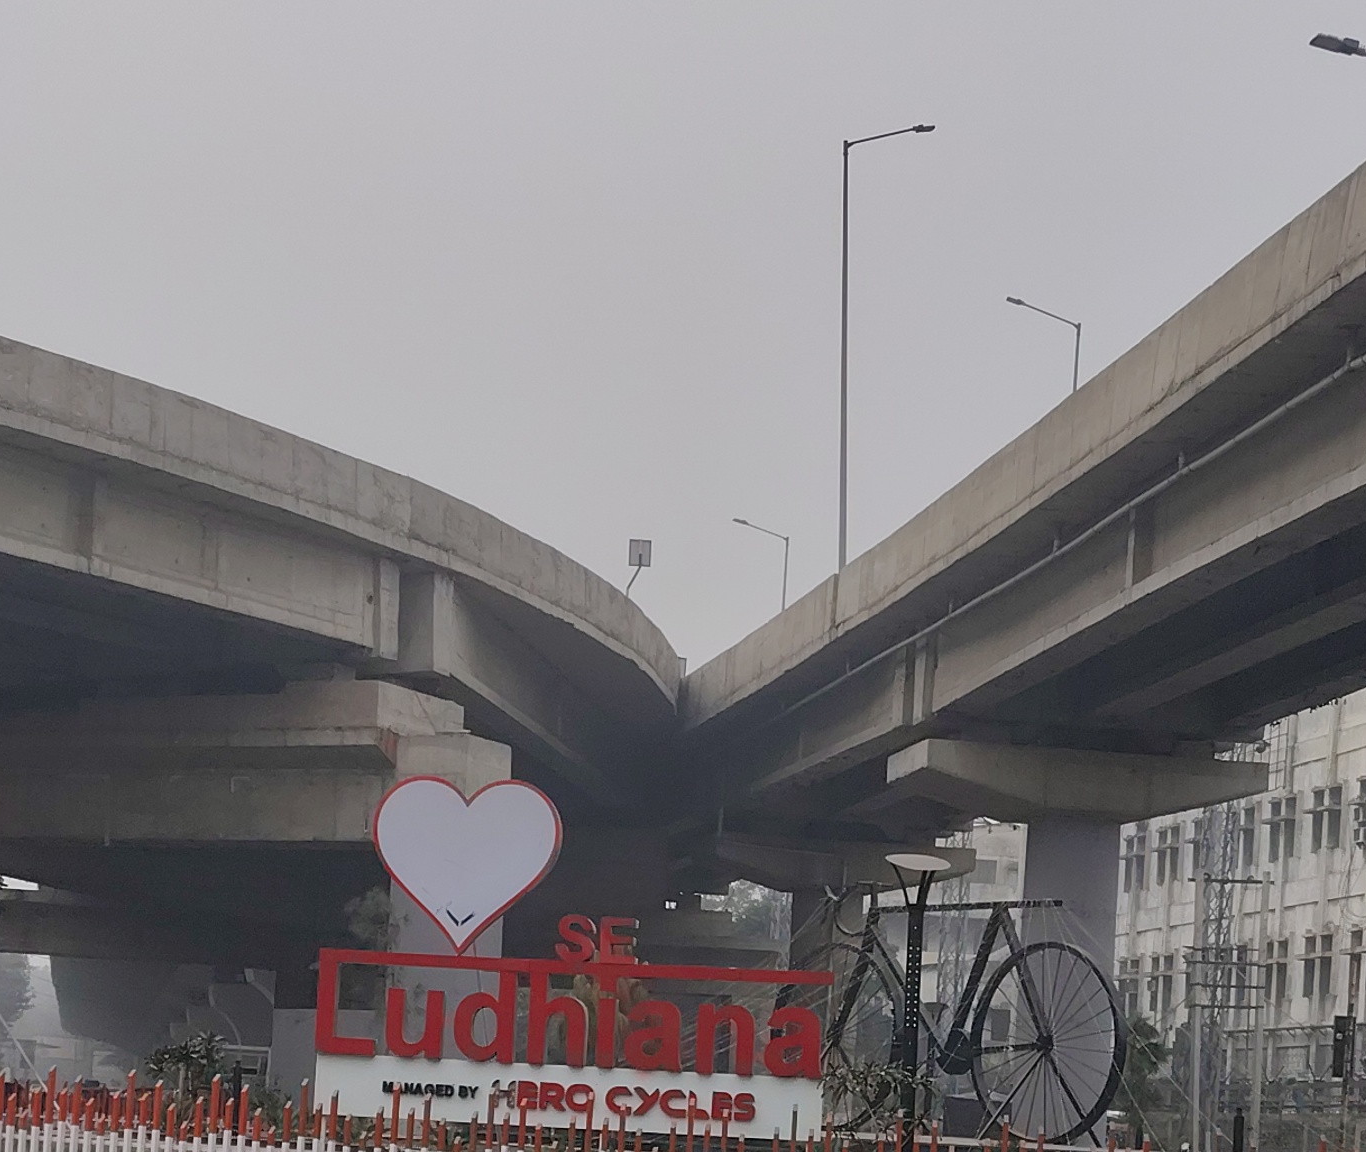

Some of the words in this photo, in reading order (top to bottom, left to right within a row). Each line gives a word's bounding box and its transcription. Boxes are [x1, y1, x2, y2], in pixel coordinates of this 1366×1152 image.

[555, 914, 641, 965] SE
[315, 948, 825, 1079] Ludhiana
[382, 1081, 455, 1098] MANAGED
[458, 1084, 479, 1100] BY
[491, 1078, 594, 1113] HERO
[605, 1085, 756, 1123] CYCLES
